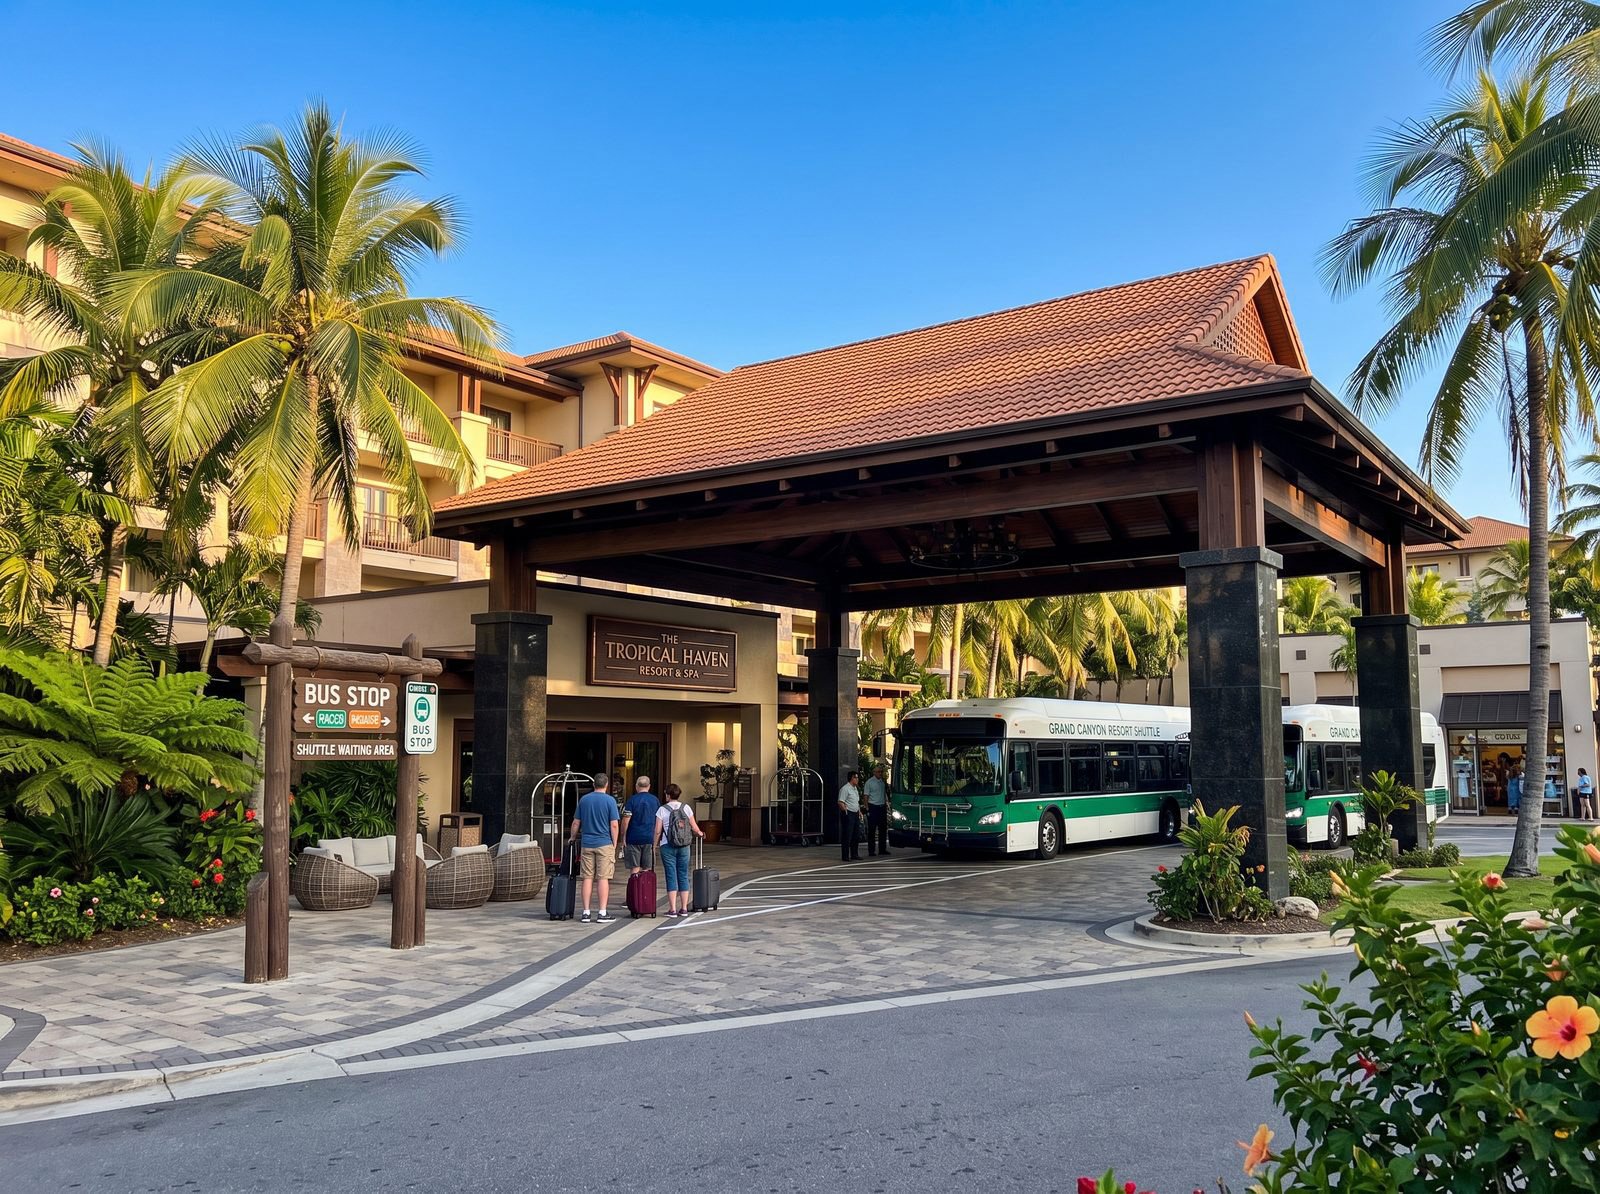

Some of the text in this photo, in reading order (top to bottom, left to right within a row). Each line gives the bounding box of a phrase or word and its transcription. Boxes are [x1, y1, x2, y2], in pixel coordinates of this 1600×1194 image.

[661, 633, 679, 645] THE
[604, 641, 728, 668] TROPICAL HAVEN
[639, 665, 700, 679] RESORT & SPA
[304, 683, 341, 705] BUS
[346, 685, 390, 707] STOP
[412, 725, 431, 735] BUS
[1048, 722, 1161, 737] GRAND CANYON RESORT SHUTTLE
[410, 737, 433, 747] STOP
[296, 743, 395, 756] SHUTTLE WAITING AREA
